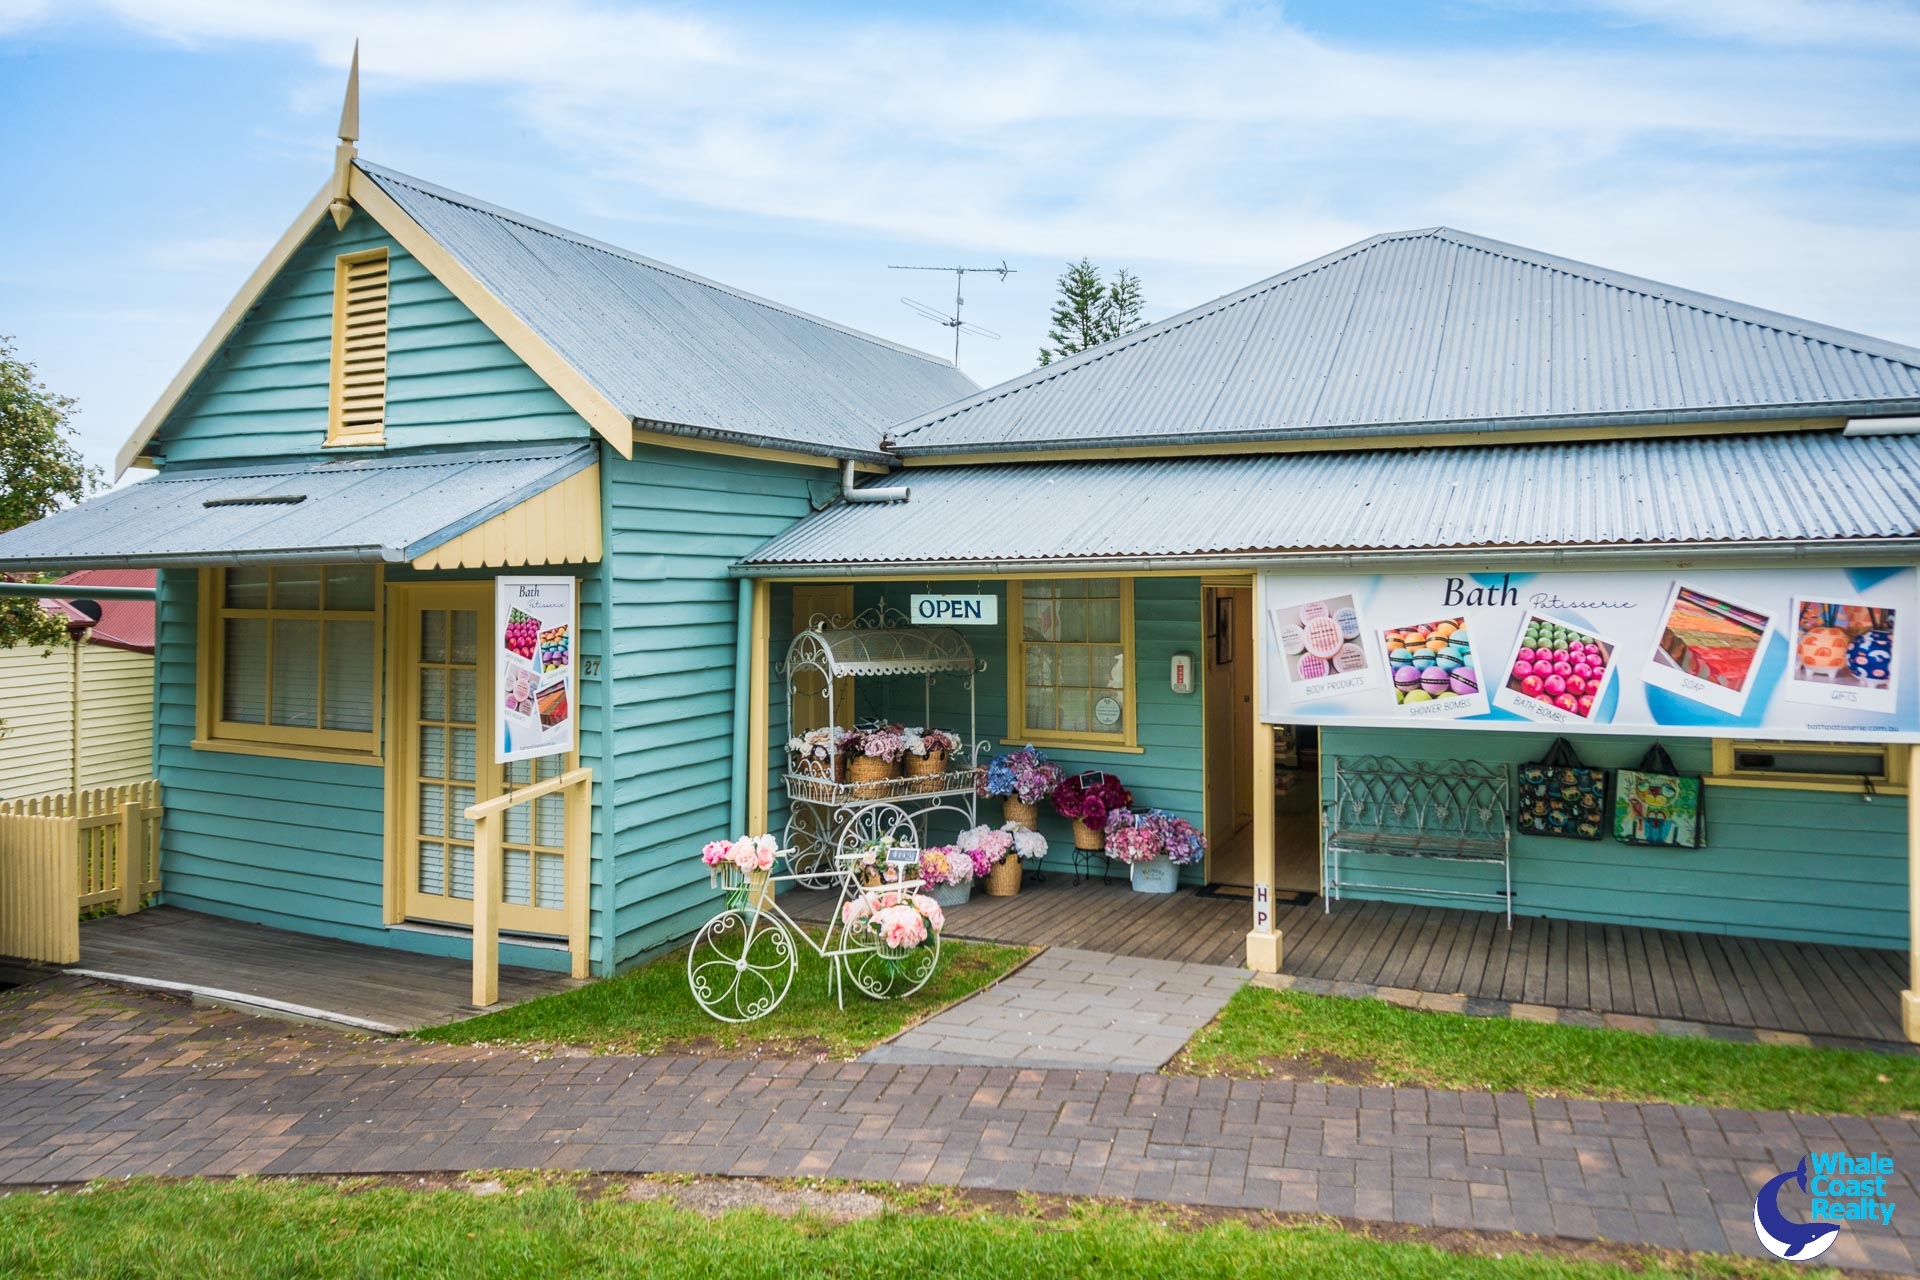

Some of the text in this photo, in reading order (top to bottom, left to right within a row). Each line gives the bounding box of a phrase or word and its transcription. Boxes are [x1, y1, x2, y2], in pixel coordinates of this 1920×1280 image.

[519, 584, 540, 597] Bath
[1442, 573, 1638, 609] Bath Patisserie
[919, 600, 981, 618] OPEN
[584, 660, 601, 676] 27
[1306, 677, 1365, 695] BODY PRODUCTS
[1682, 678, 1705, 691] SOAP
[1409, 698, 1472, 716] SHOWER BOMBS
[1513, 696, 1567, 723] BATH BOMBS
